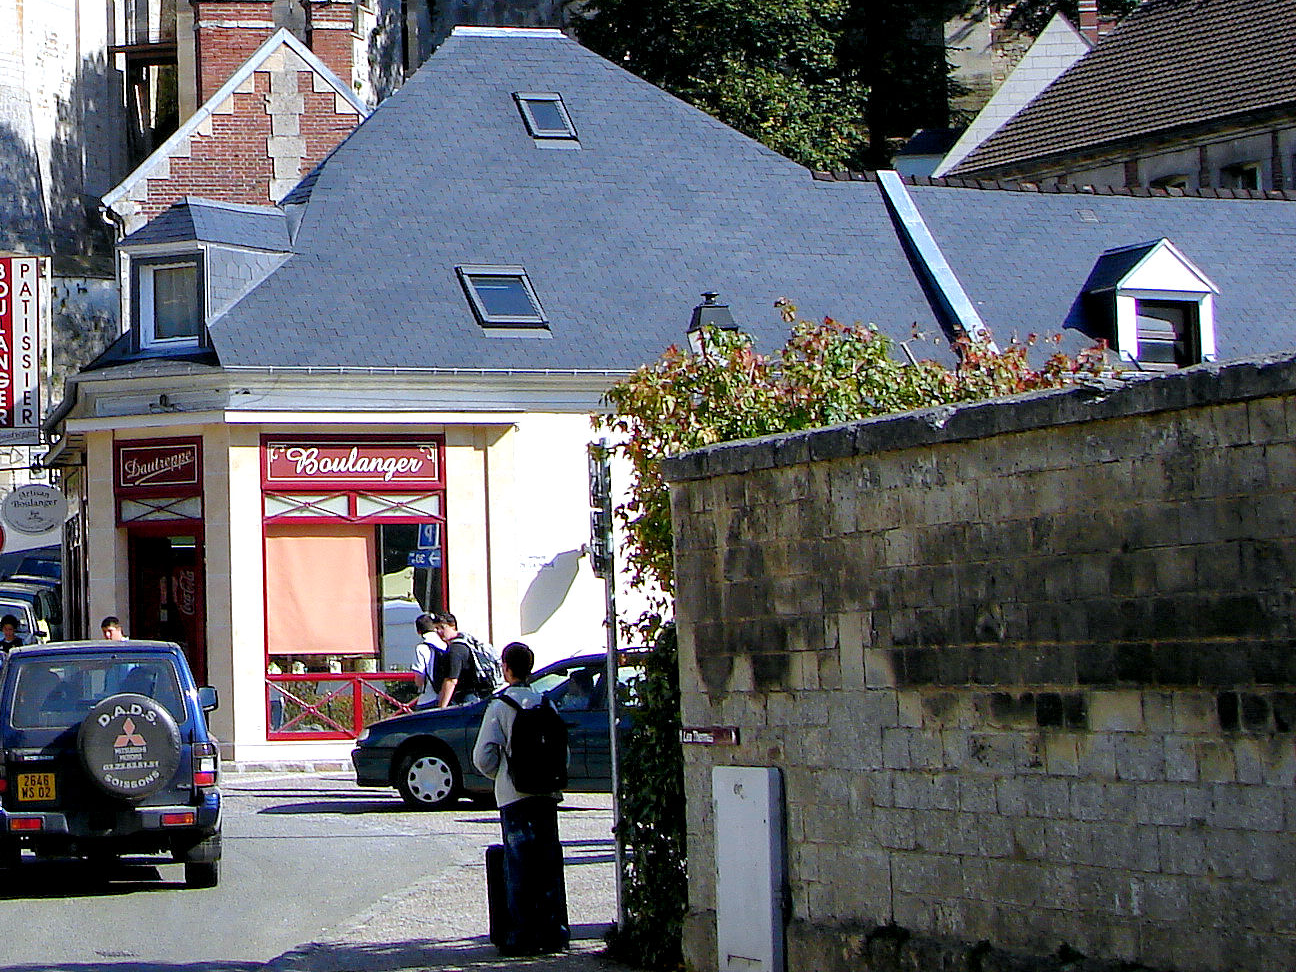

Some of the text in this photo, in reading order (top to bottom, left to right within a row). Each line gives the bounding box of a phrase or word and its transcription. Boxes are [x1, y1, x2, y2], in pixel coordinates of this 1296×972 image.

[19, 264, 33, 425] PATISSIER
[286, 446, 423, 482] Boulanger
[11, 499, 58, 508] Boulanger
[19, 490, 50, 500] Artisan
[98, 704, 157, 727] D.A.D.S.
[104, 770, 160, 788] SOISSONS
